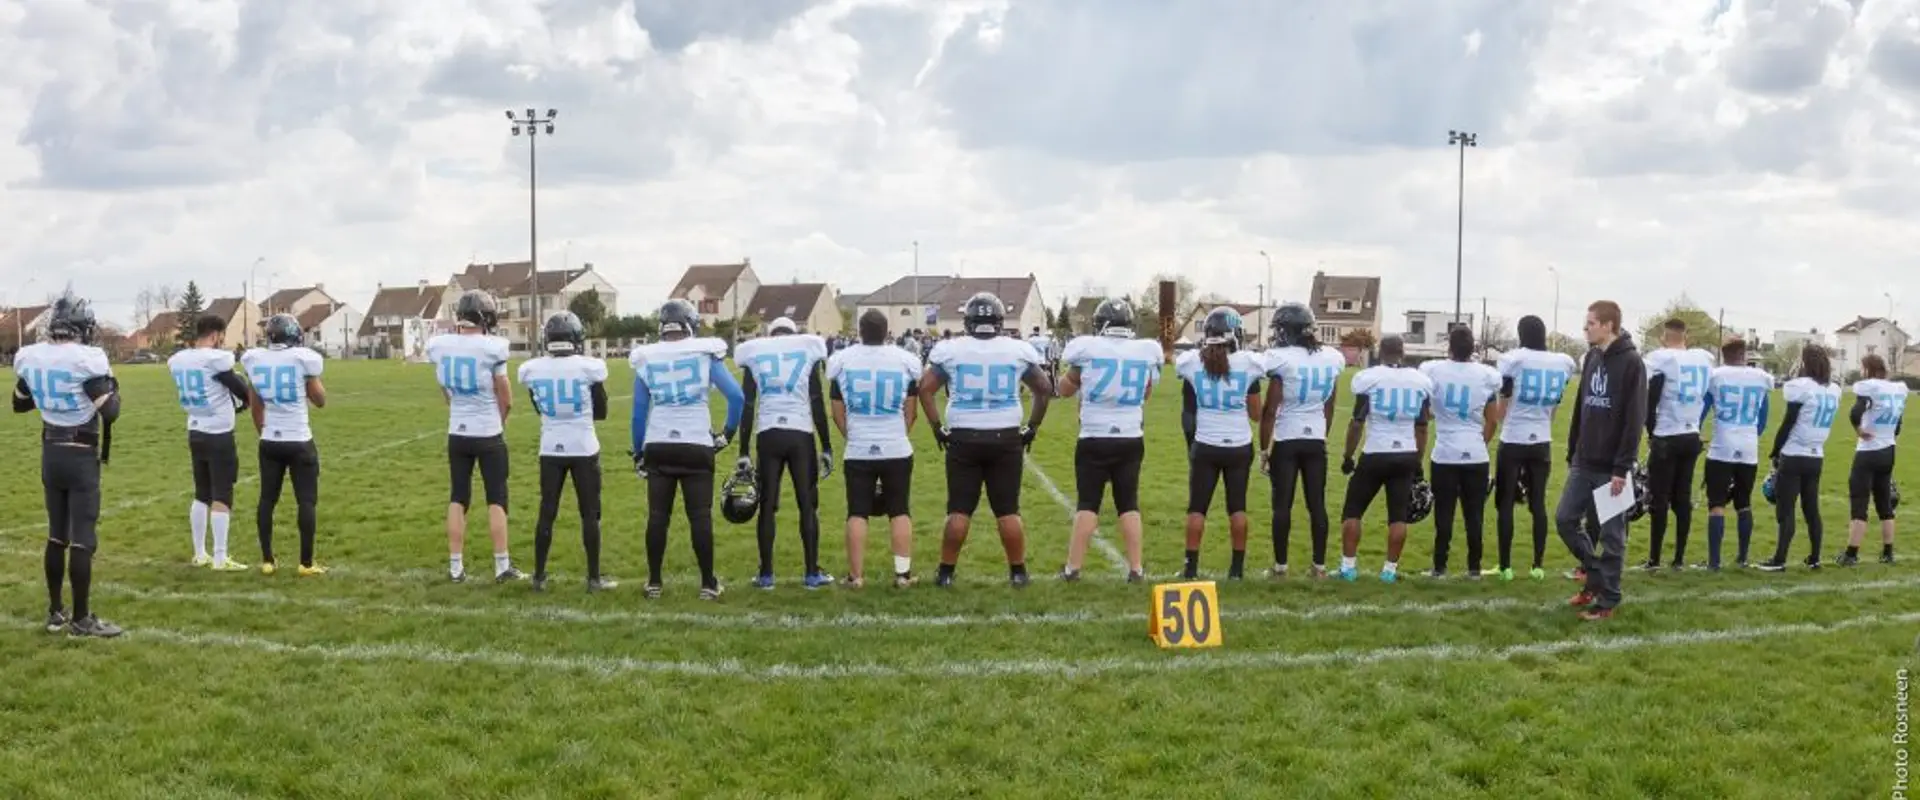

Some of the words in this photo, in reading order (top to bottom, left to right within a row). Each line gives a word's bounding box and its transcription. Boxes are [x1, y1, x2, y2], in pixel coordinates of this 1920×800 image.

[254, 365, 299, 404] 28
[442, 355, 478, 395] 10
[755, 350, 808, 395] 27
[953, 364, 1017, 409] 59
[1088, 358, 1148, 405] 79
[1298, 366, 1334, 403] 14
[1517, 368, 1565, 405] 88
[1679, 365, 1709, 404] 21
[1373, 387, 1424, 421] 44
[1445, 382, 1470, 421] 4
[1162, 588, 1211, 644] 50
